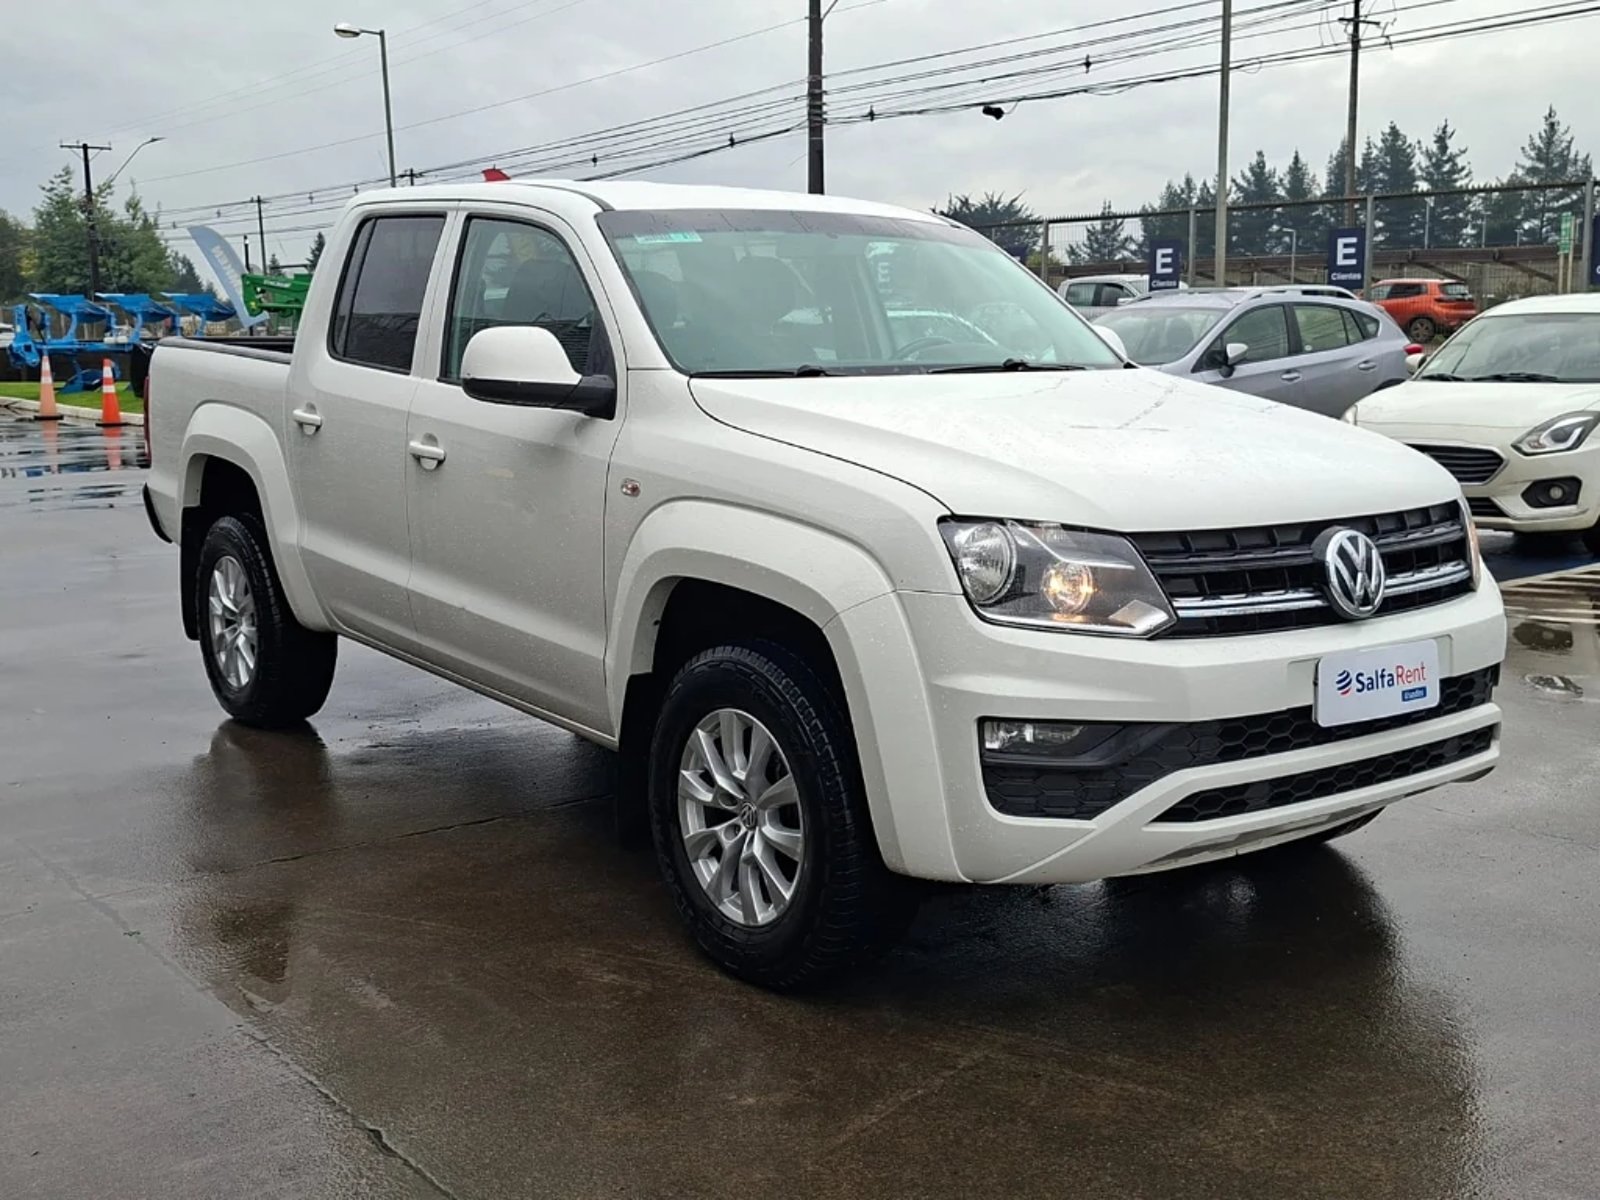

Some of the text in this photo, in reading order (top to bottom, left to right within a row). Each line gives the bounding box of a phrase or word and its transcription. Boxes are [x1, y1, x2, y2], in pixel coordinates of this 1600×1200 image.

[1155, 248, 1174, 274] E
[1336, 237, 1358, 265] E
[1355, 661, 1426, 693] SalfaRent
